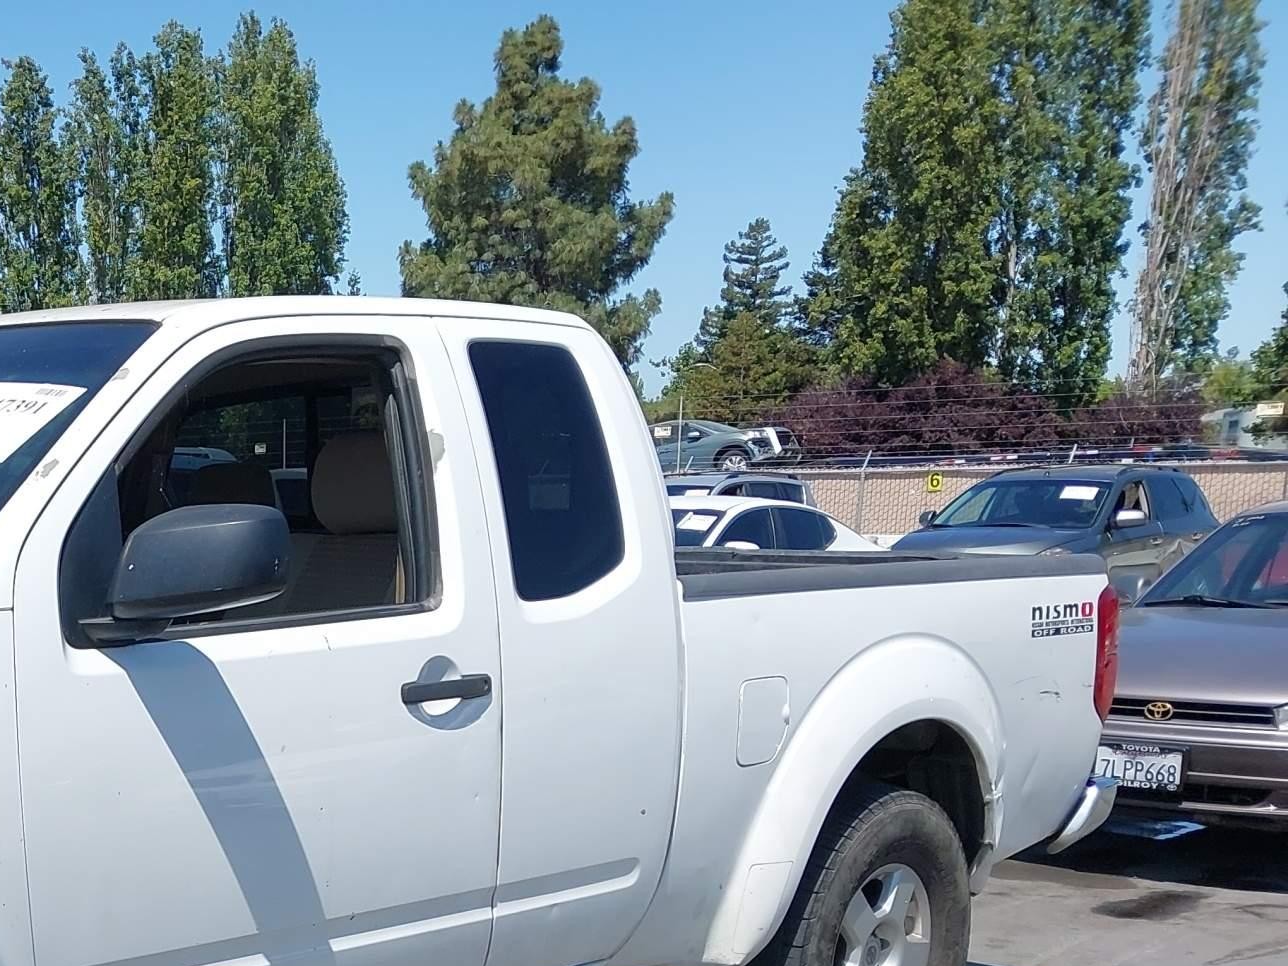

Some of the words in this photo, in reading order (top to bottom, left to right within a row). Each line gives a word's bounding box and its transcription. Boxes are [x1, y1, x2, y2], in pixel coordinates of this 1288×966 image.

[930, 472, 940, 488] 6
[1032, 602, 1094, 621] nismo
[1033, 628, 1057, 637] OFF
[1059, 625, 1092, 635] ROAD
[1121, 744, 1161, 753] TOYOTA
[1101, 758, 1177, 785] 7LPP668
